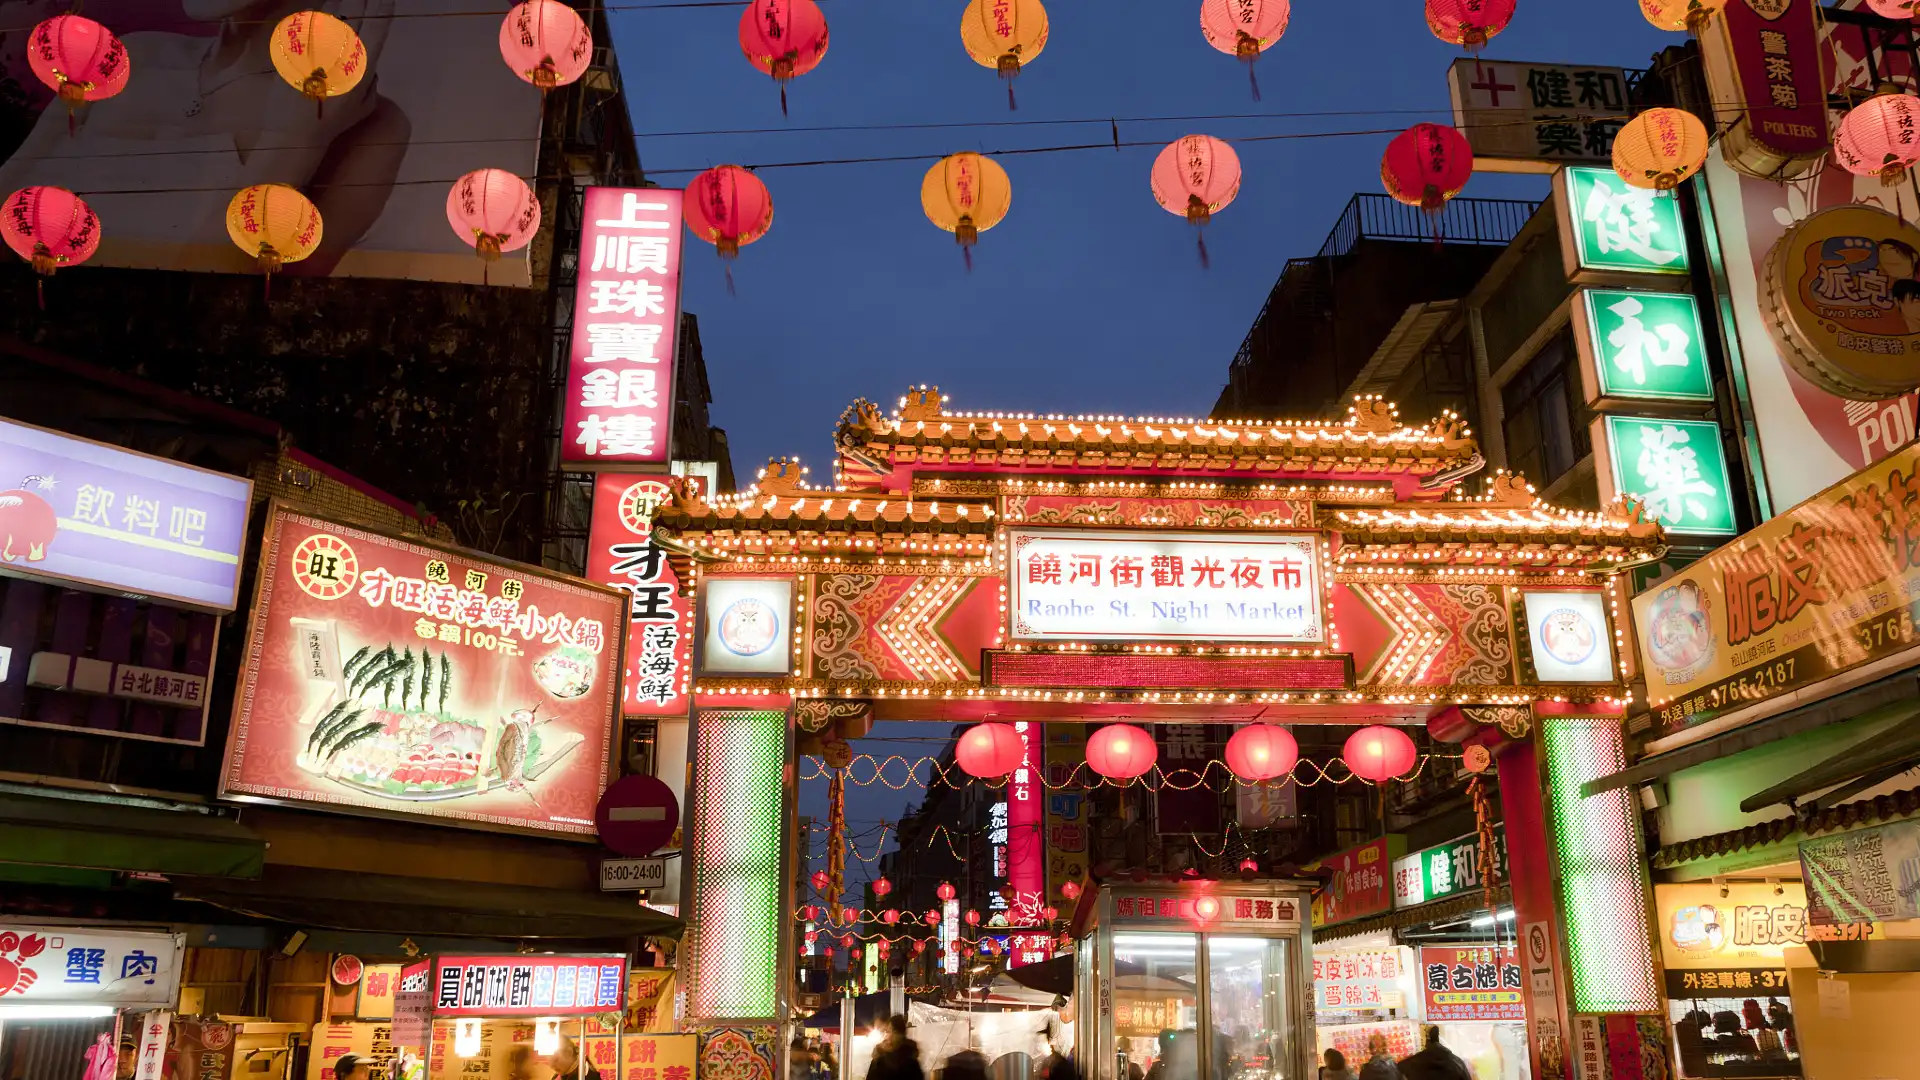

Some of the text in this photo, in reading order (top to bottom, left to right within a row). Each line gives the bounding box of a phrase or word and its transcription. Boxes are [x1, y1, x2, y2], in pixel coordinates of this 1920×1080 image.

[1526, 68, 1624, 111] 健和
[1763, 120, 1817, 139] POLTERS
[1817, 264, 1893, 308] 派克
[576, 192, 670, 456] 上順珠寶銀樓
[1818, 306, 1880, 319] Two Peck
[70, 483, 207, 547] 飲料吧
[310, 552, 340, 582] 旺
[427, 561, 524, 600] 饒河街
[1028, 552, 1303, 590] 饒河街觀光夜市
[360, 569, 604, 652] 才旺活海鮮小火鍋
[1028, 599, 1304, 623] Raohe St. Night Market
[640, 626, 677, 703] 活海鮮
[120, 669, 201, 701] 台北饒河店
[603, 864, 662, 881] 16:00-24:00
[1430, 833, 1507, 894] 健和
[1235, 897, 1295, 920] 服務台
[63, 948, 158, 985] 蟹肉
[1427, 963, 1521, 991] 蒙古烤肉
[437, 964, 621, 1009] 買胡椒餅送蟹殼黃
